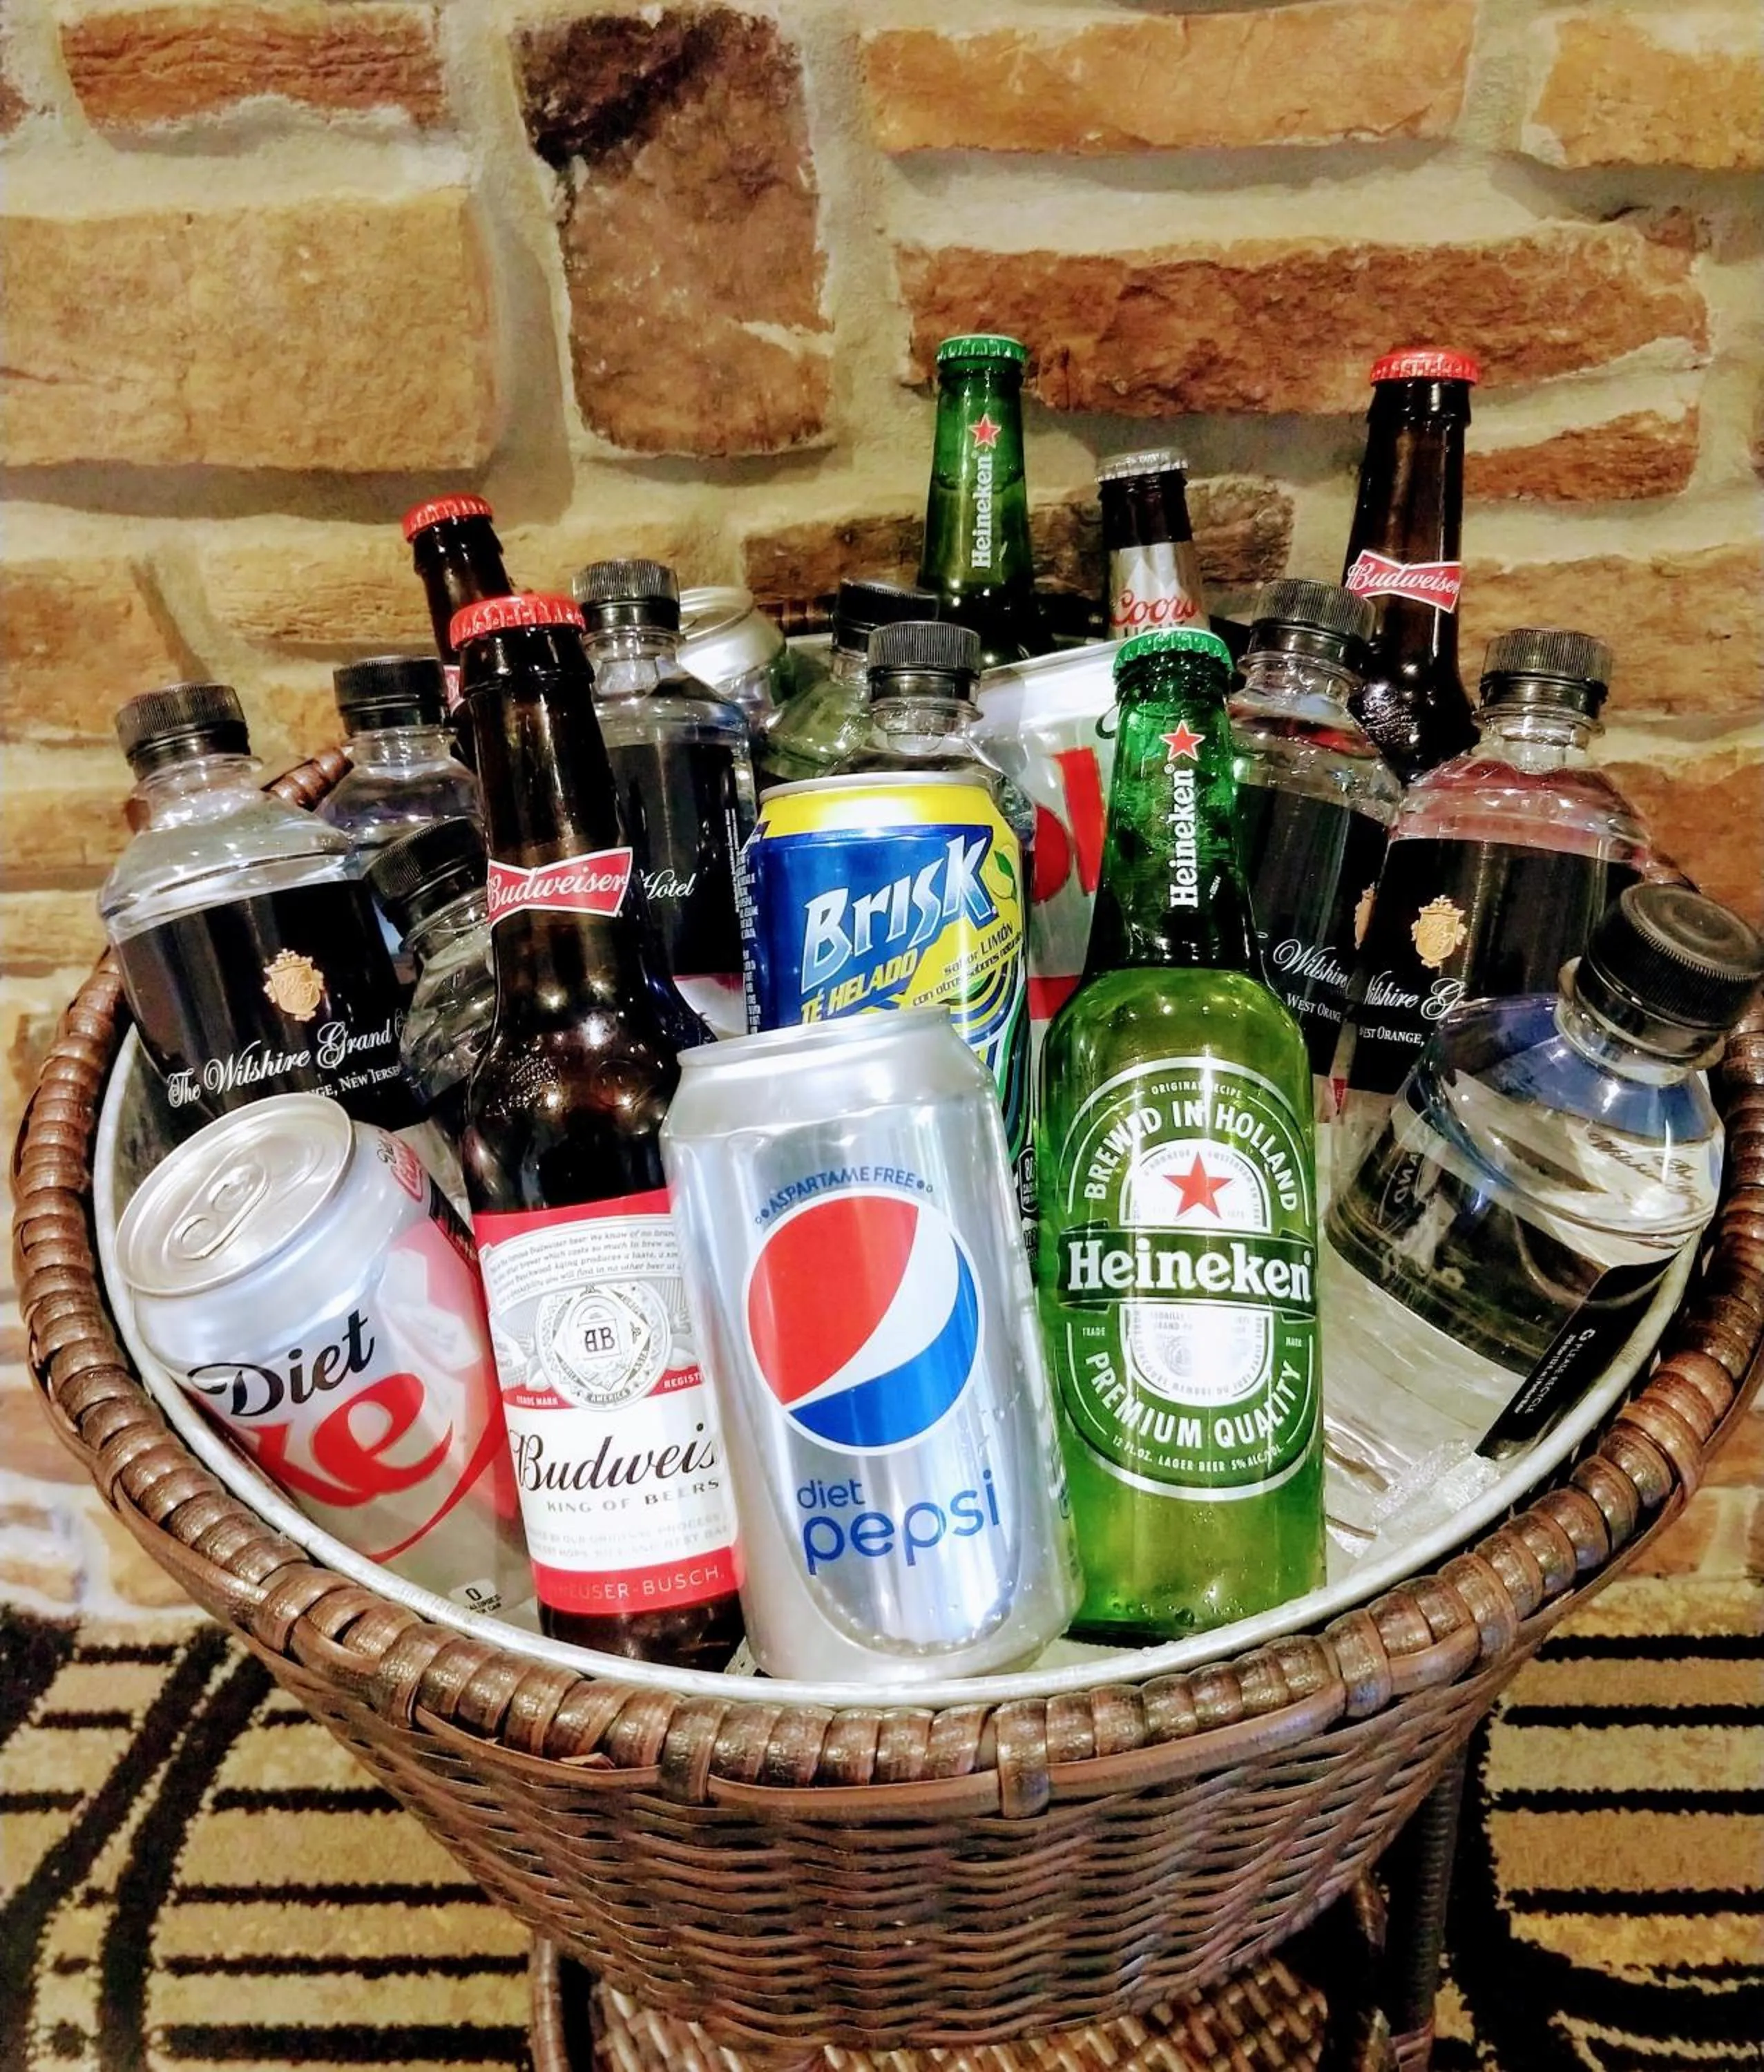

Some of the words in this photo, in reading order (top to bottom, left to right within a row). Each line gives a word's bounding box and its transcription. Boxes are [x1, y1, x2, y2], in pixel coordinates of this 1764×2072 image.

[971, 452, 993, 569] Heineken
[1345, 562, 1460, 595] Budweiser
[1111, 588, 1201, 627] Coors
[1167, 769, 1199, 909] Heineken
[487, 866, 629, 912] Budweiser
[827, 948, 918, 1015] HELADO
[944, 950, 979, 975] saor
[1272, 938, 1349, 988] Wilshire
[167, 1067, 201, 1109] The
[204, 1039, 311, 1095] Wilshire
[316, 1017, 393, 1070] Grand
[367, 1065, 401, 1084] JERSE
[1207, 1082, 1243, 1099] ECIPE
[1084, 1106, 1162, 1200] BREWED
[1171, 1099, 1207, 1129] IN
[1214, 1102, 1298, 1212] HOLLAND
[767, 1165, 871, 1214] ASPARTAME
[872, 1166, 916, 1189] FREE
[1066, 1237, 1312, 1304] Heineken
[187, 1309, 375, 1417] Diet
[663, 1373, 703, 1388] REGIST
[1085, 1350, 1203, 1448] PREMIUM
[1214, 1358, 1302, 1449] QUALITY
[509, 1421, 718, 1493] Budweis
[1158, 1455, 1194, 1471] LAGER
[1198, 1460, 1225, 1473] BEER
[546, 1499, 593, 1514] KING
[602, 1497, 632, 1511] OF
[644, 1479, 720, 1506] BEERS
[796, 1477, 867, 1510] diet
[801, 1468, 1001, 1576] pepsi
